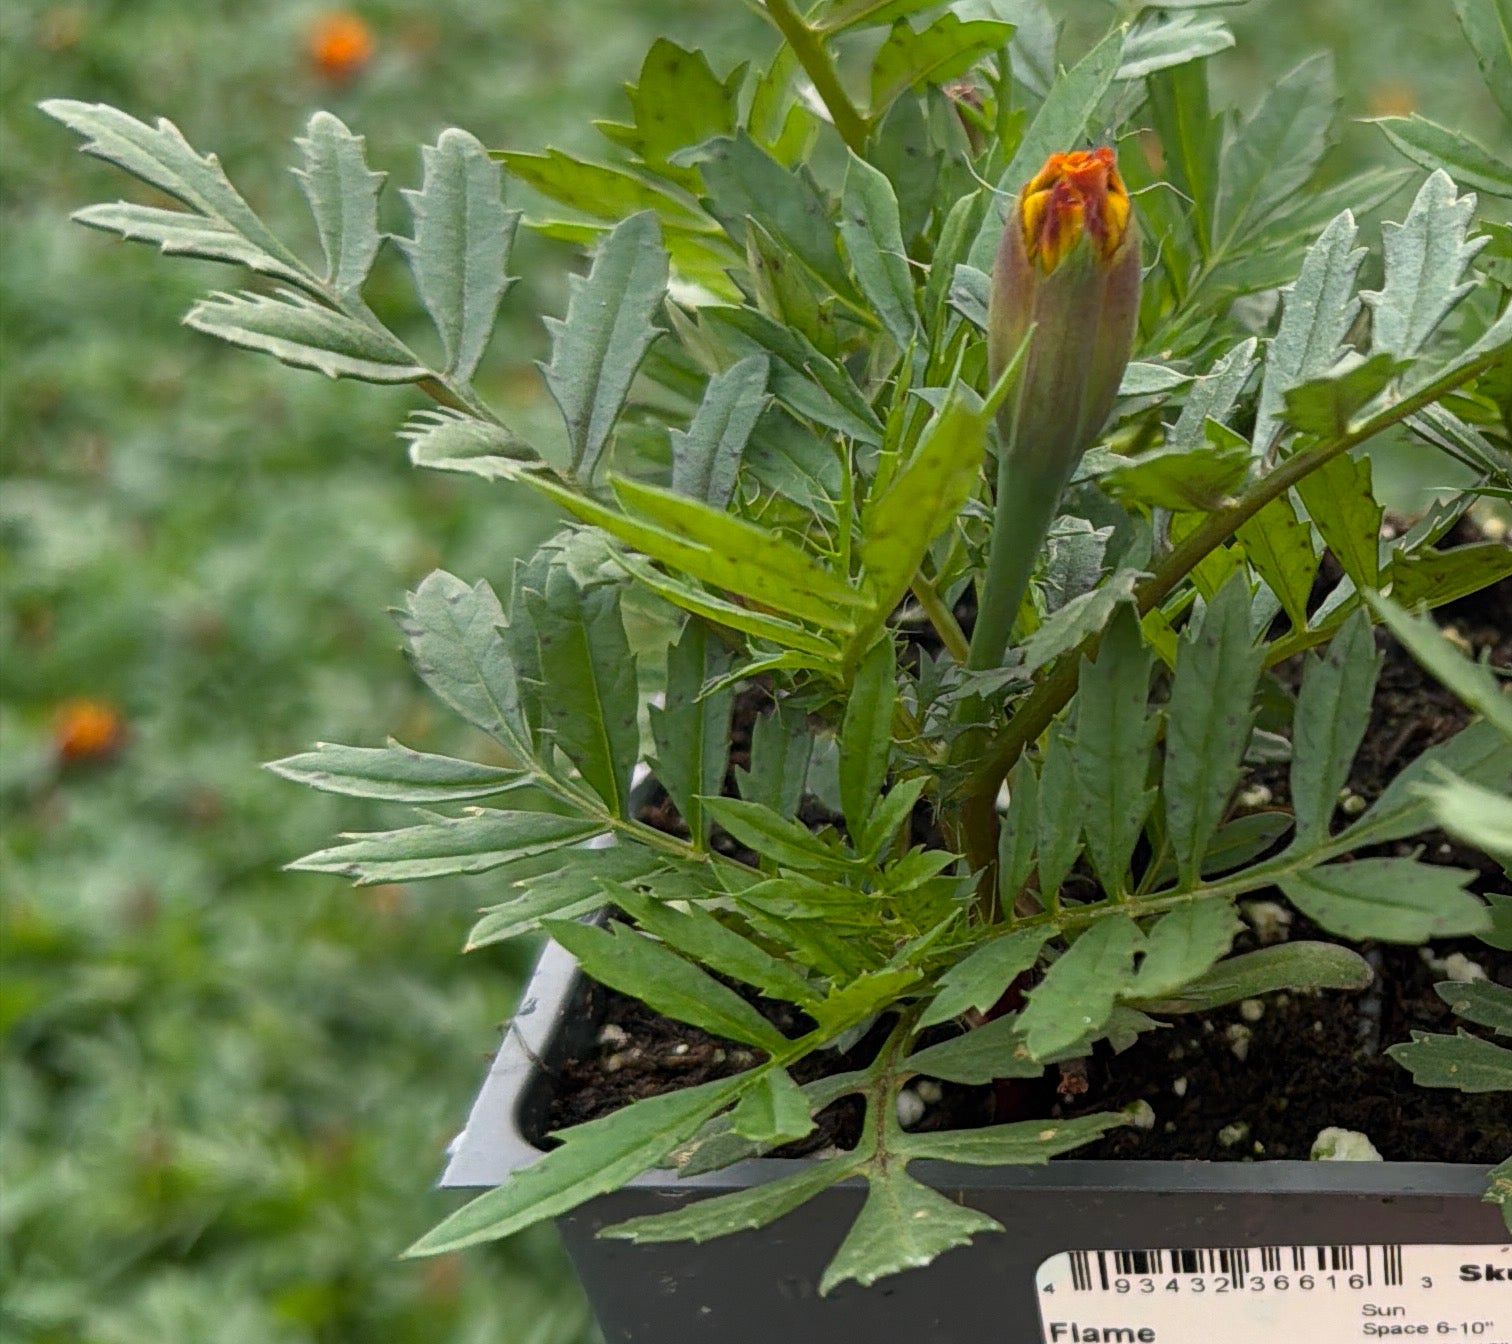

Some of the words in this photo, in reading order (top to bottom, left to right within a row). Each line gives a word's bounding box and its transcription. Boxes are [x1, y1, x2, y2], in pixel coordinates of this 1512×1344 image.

[1043, 1282, 1055, 1294] 4
[1421, 1275, 1433, 1289] 3
[1362, 1304, 1406, 1317] Sun
[1050, 1322, 1156, 1344] Flame
[1363, 1322, 1429, 1338] Space
[1436, 1320, 1494, 1335] 6-10"
